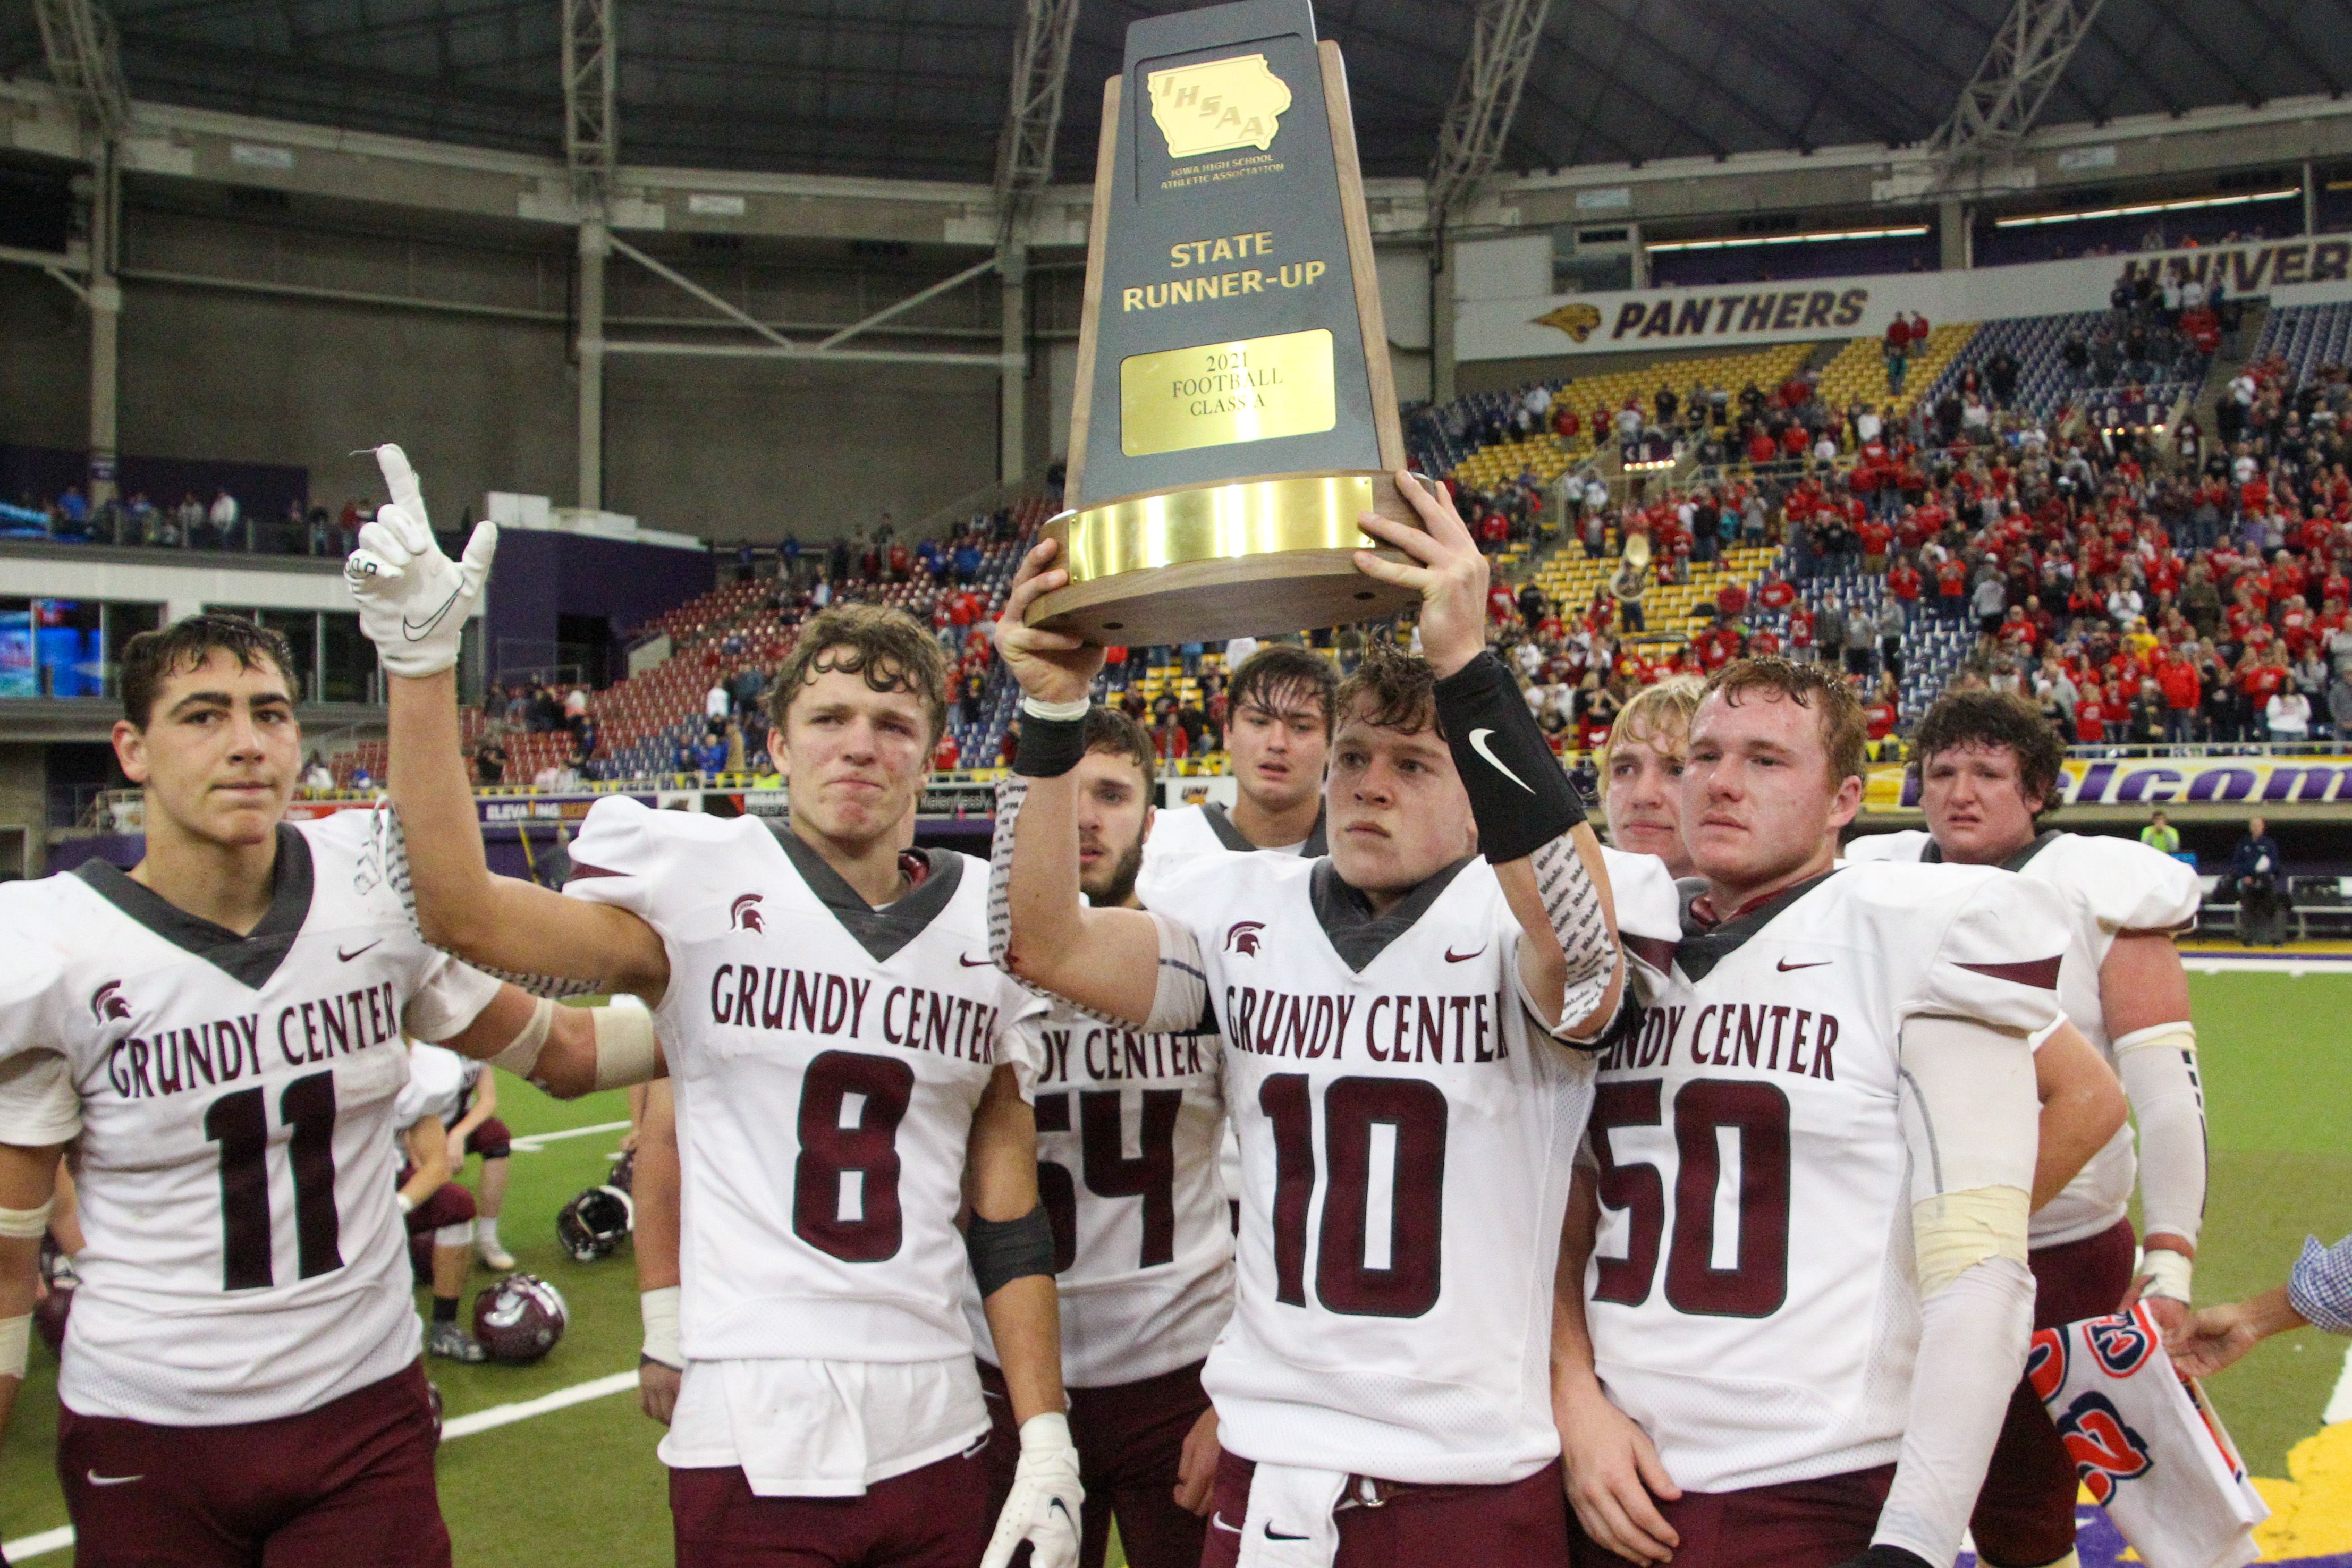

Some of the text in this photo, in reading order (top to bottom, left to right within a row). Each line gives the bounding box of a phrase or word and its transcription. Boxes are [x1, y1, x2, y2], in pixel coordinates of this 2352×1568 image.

[1161, 76, 1265, 139] IHSAA
[1161, 163, 1284, 189] ATHLETIC ASSOCIATION
[1171, 154, 1274, 177] IOWA HIGH SCHOOL
[1171, 230, 1273, 268] STATE
[1123, 260, 1326, 312] RUNNER-UP
[1610, 289, 1868, 340] PANTHERS
[1172, 368, 1283, 397] FOOTBALL
[1206, 351, 1248, 372] 2021
[1190, 394, 1266, 417] CLASS A
[710, 964, 871, 1038] GRUNDY
[1226, 986, 1356, 1060] GRUNDY
[109, 981, 397, 1099] GRUNDY CENTER
[1085, 1027, 1203, 1081] CENTER
[1690, 1004, 1839, 1081] CENTER
[203, 1070, 345, 1291] 11
[792, 1049, 915, 1264] 8
[1259, 1072, 1448, 1319] 10
[1589, 1077, 1790, 1319] 50
